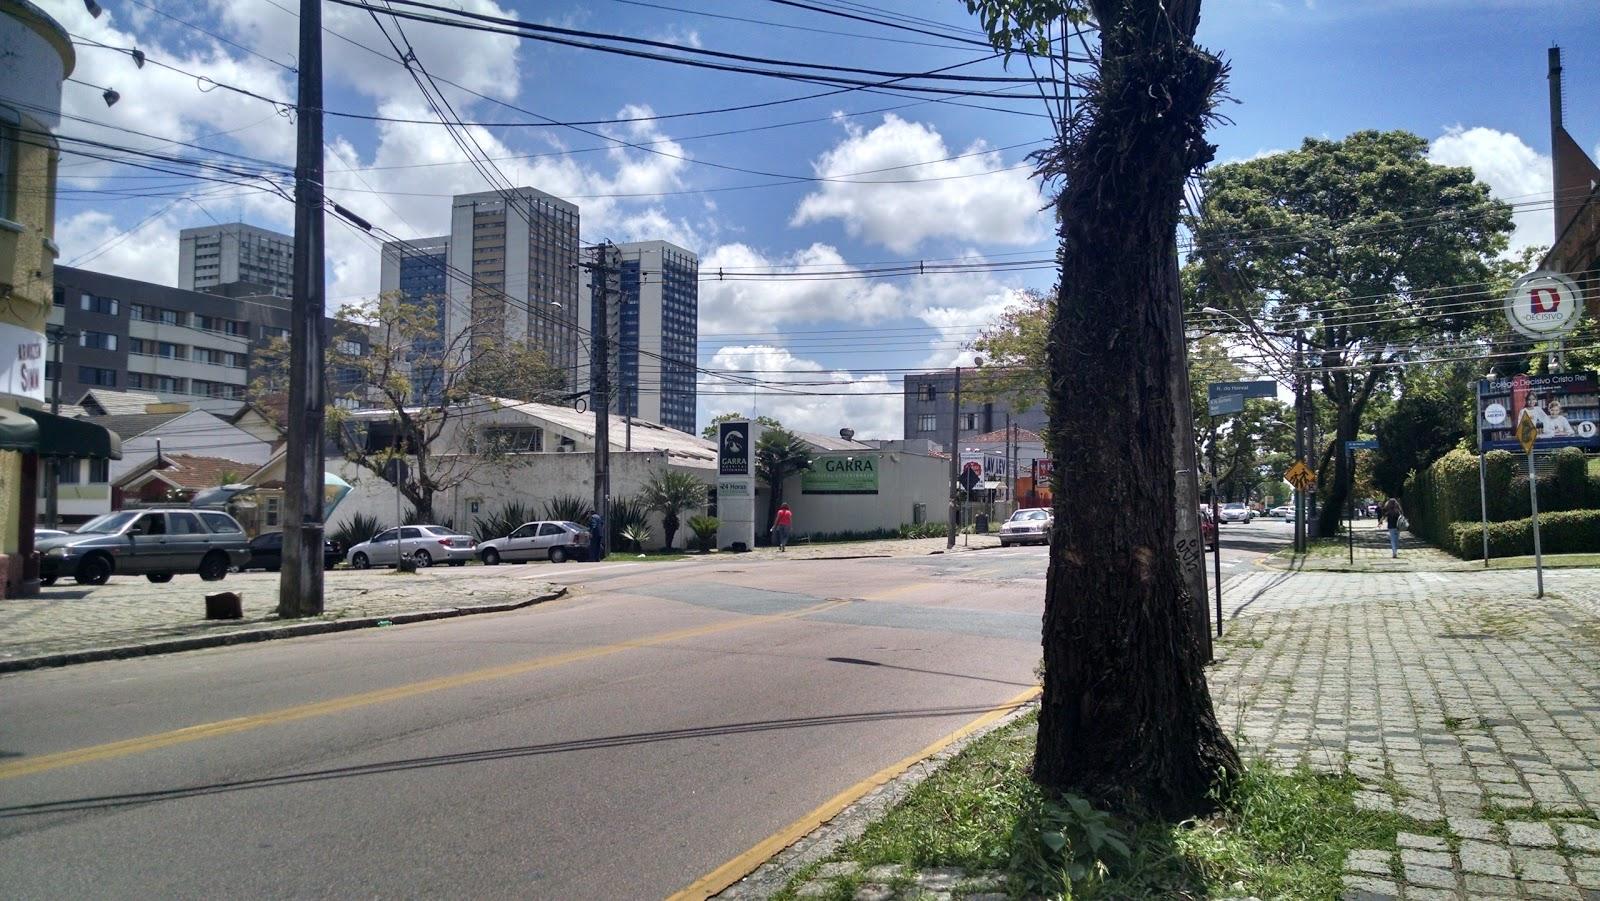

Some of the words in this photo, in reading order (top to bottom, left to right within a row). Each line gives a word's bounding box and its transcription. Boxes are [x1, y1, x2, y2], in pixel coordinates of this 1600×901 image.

[1525, 312, 1563, 321] DECISIVO
[1520, 377, 1551, 387] Decisivo
[1552, 375, 1574, 384] Cristo
[1575, 374, 1587, 382] Rei
[722, 457, 747, 465] GARRA
[825, 460, 873, 472] GARRA
